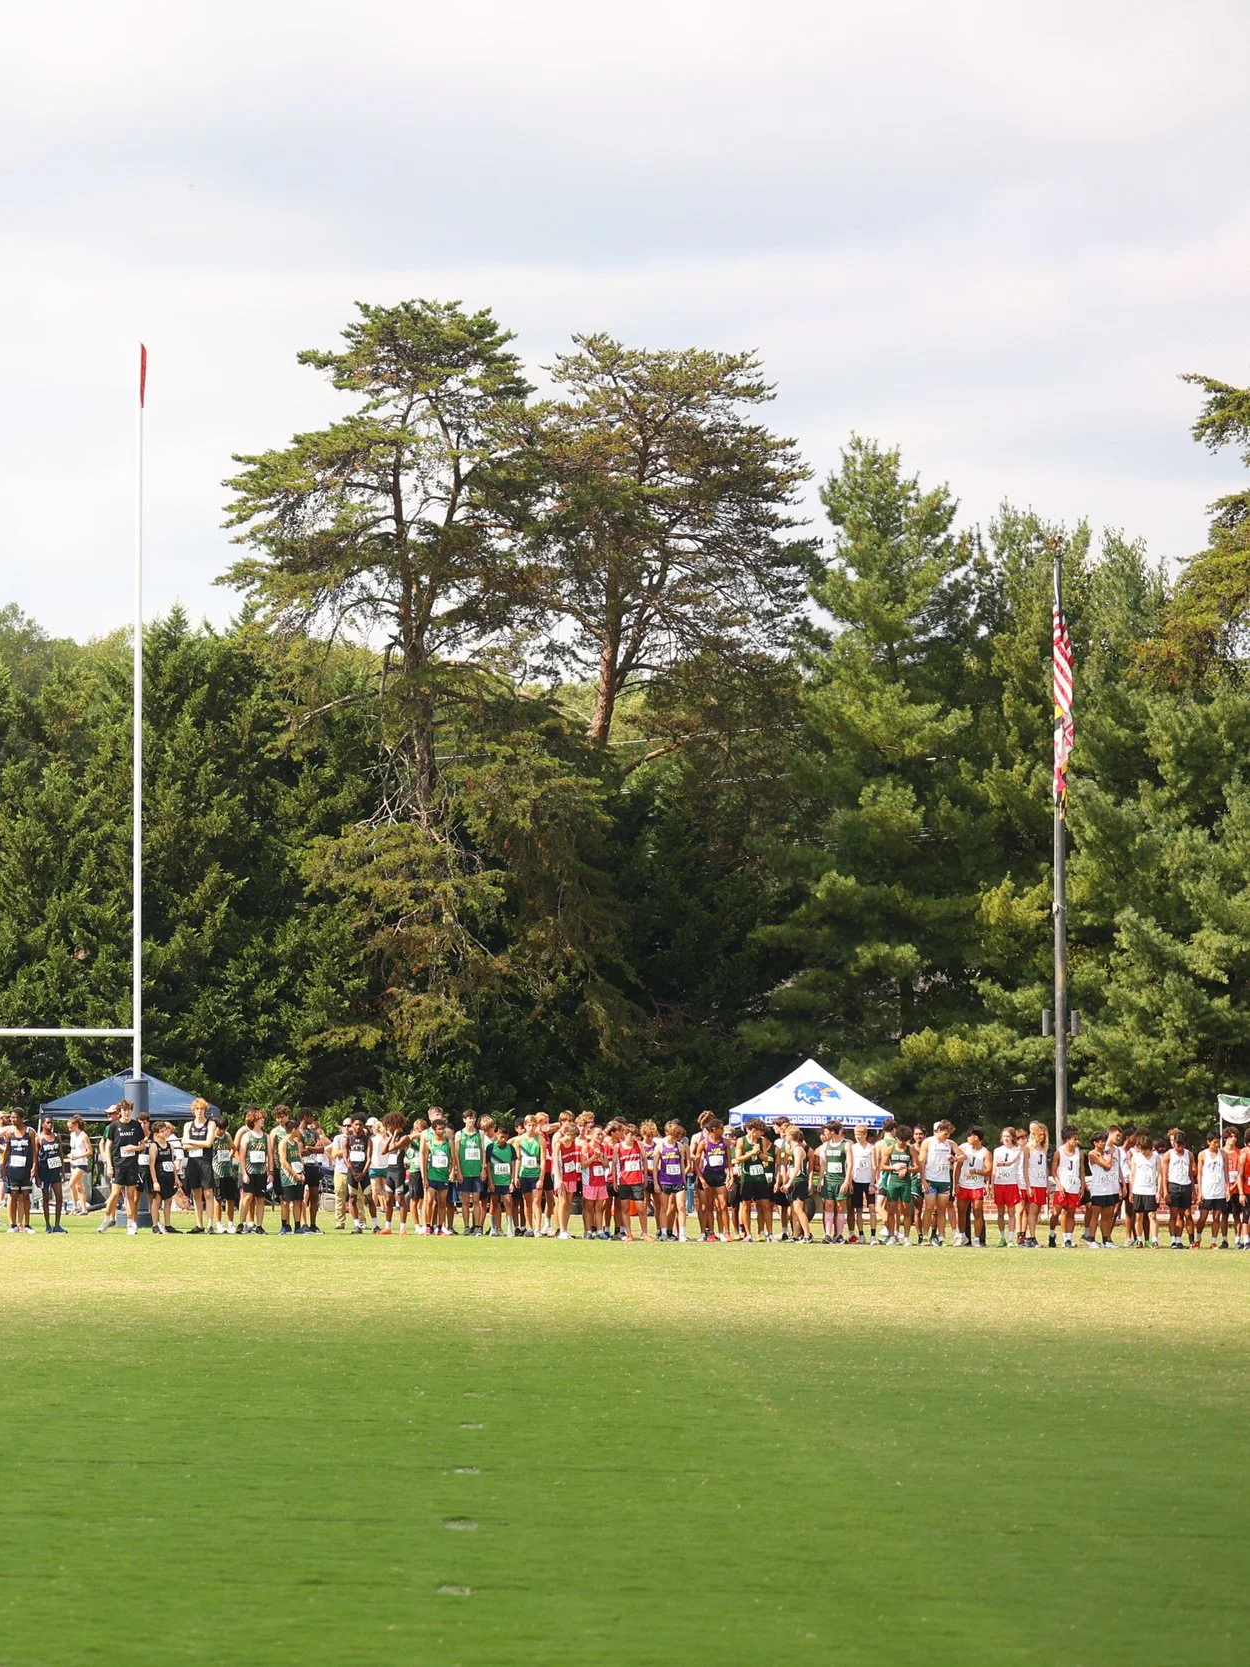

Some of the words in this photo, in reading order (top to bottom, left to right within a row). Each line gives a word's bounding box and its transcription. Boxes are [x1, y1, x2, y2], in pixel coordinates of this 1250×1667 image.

[969, 1157, 975, 1167] J
[1037, 1154, 1043, 1165] J
[1067, 1160, 1073, 1171] J
